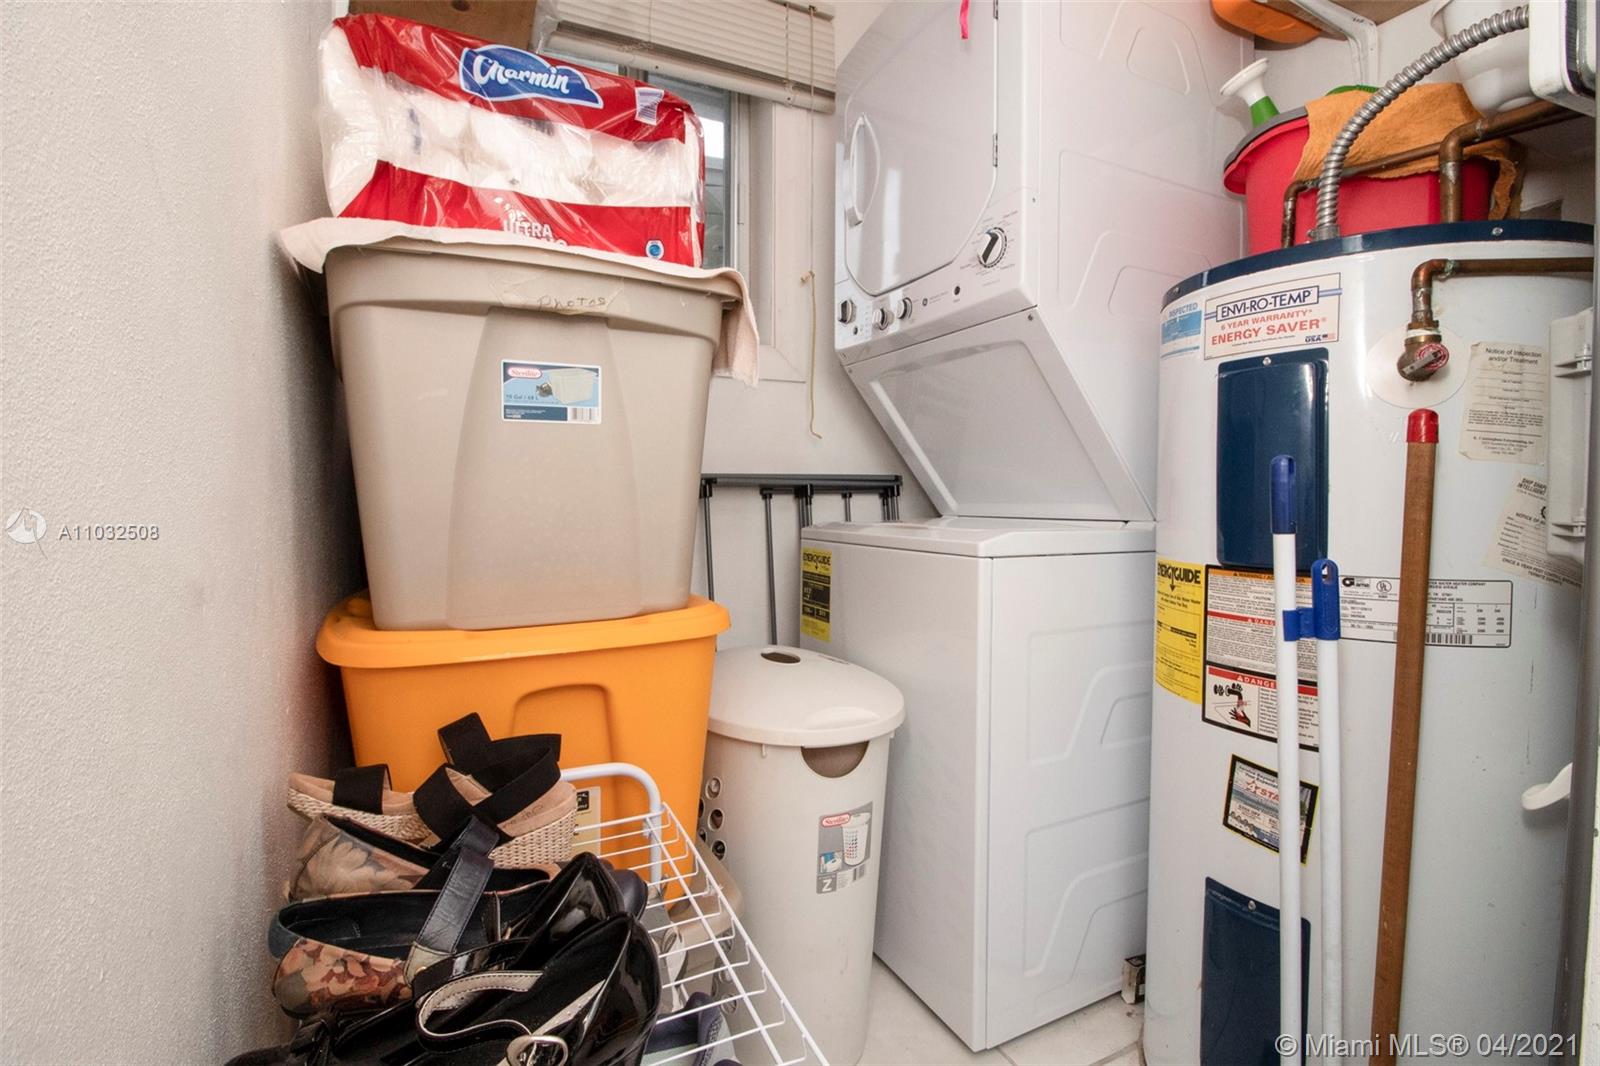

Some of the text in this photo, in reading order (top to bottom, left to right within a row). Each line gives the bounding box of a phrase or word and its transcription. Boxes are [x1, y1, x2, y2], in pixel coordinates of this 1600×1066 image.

[473, 56, 571, 94] Charmin
[1221, 290, 1312, 318] ENVI-RO-TEMP
[1226, 318, 1249, 330] YEAR
[1211, 327, 1261, 346] ENERGY
[1514, 350, 1542, 358] Inspection
[1509, 356, 1538, 365] Treatment
[1244, 677, 1276, 688] DANGE
